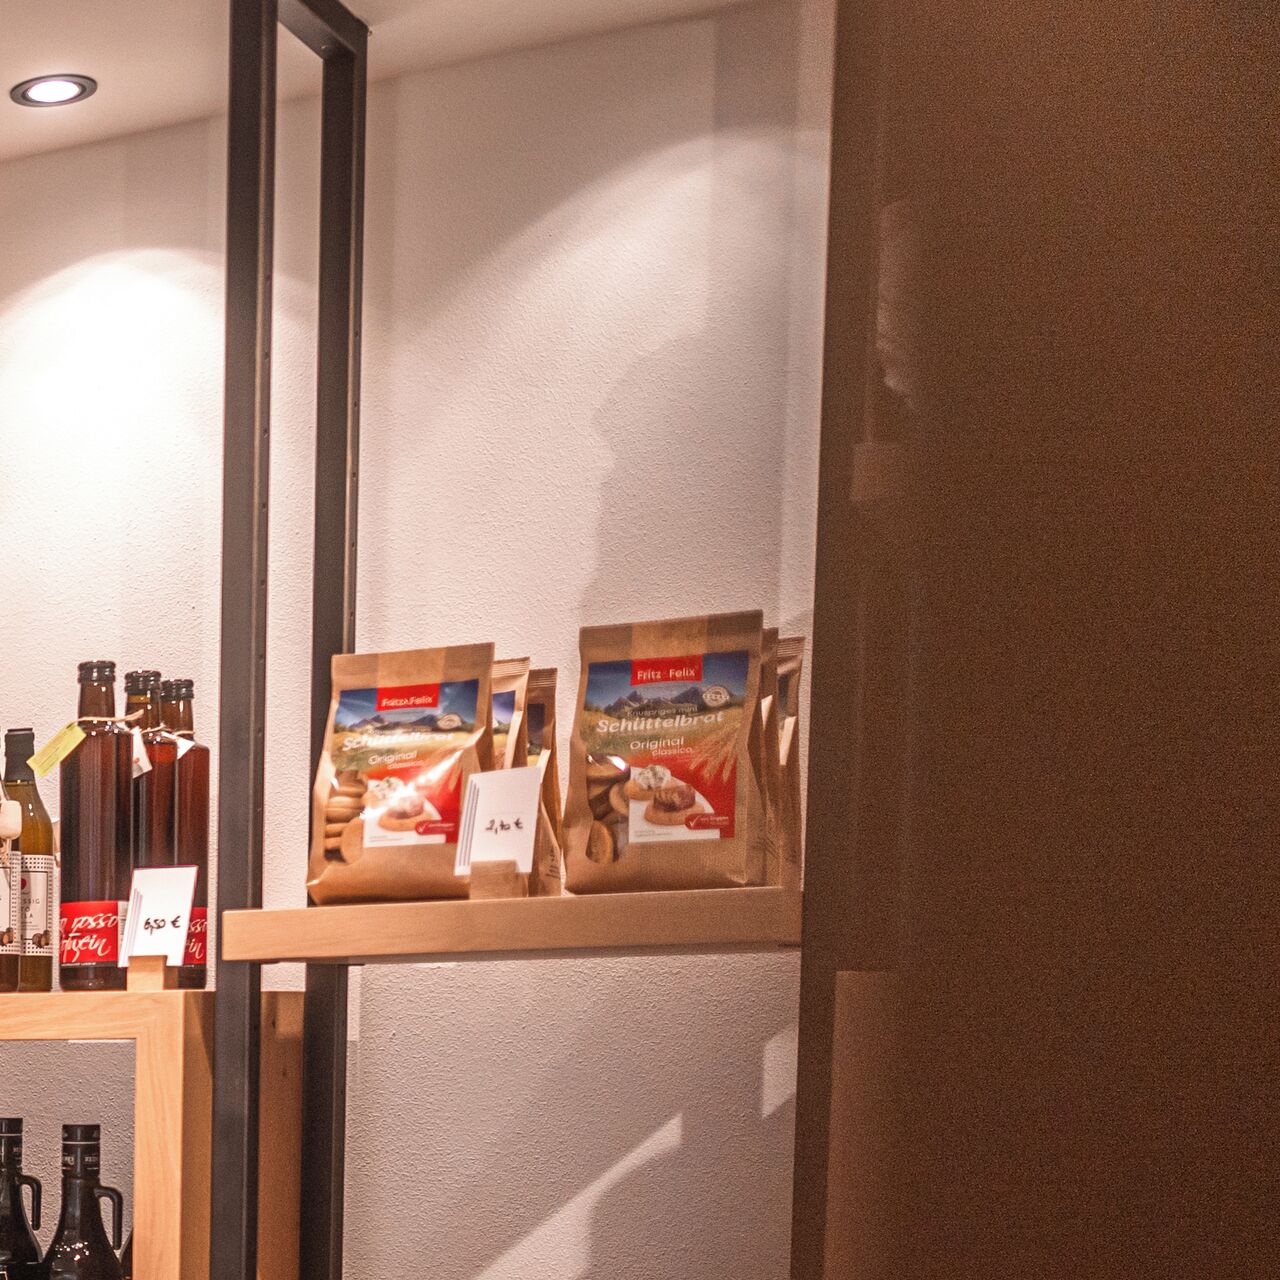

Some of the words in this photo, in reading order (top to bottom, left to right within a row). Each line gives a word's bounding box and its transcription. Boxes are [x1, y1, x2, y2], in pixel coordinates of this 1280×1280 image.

[637, 670, 661, 680] Fritz
[670, 668, 696, 678] Felix
[630, 737, 684, 751] Original
[368, 751, 418, 765] Original
[72, 912, 119, 930] rosso
[144, 917, 166, 935] 6,50
[171, 915, 181, 929] €
